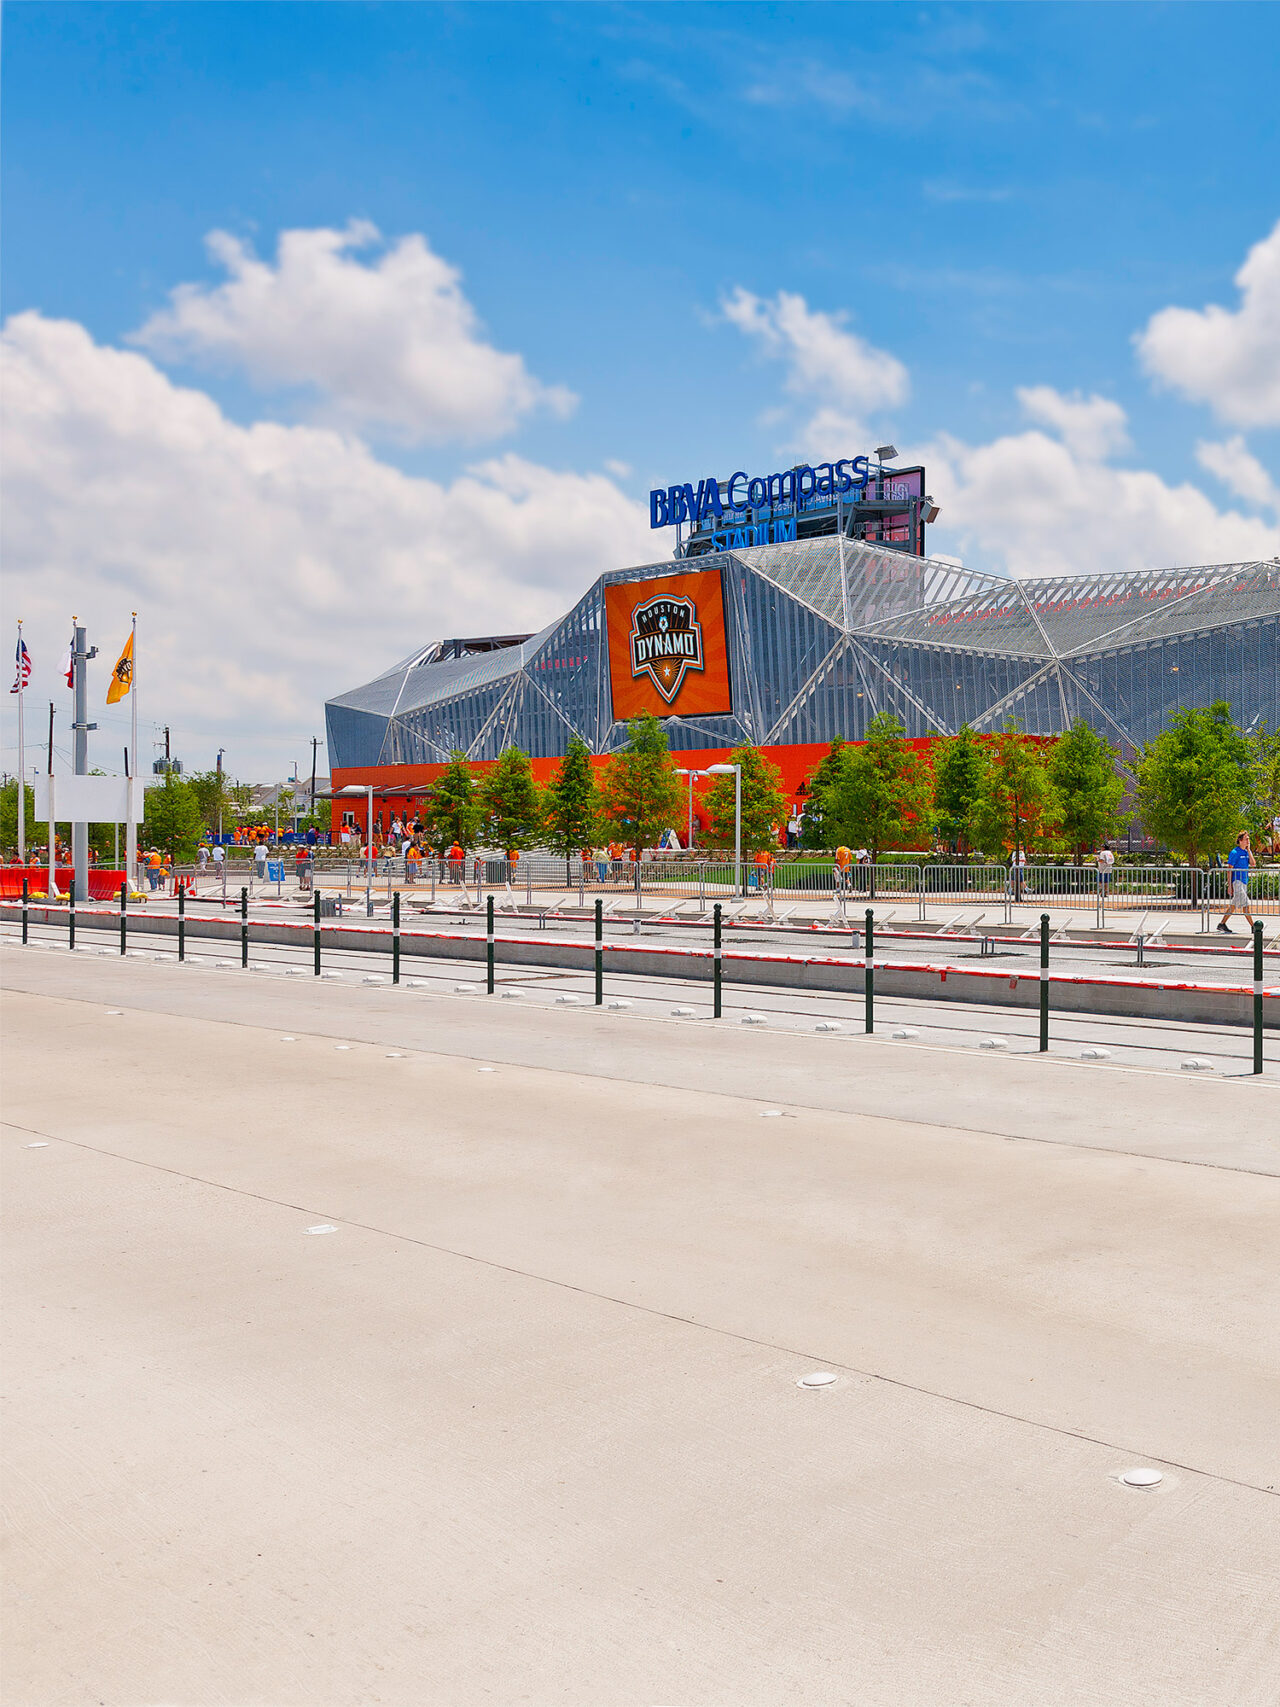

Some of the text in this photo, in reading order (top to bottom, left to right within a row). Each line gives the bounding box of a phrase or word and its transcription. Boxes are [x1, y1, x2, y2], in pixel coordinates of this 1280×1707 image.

[650, 455, 869, 529] BBVA Compass
[711, 518, 798, 552] STADIUM
[641, 604, 686, 624] HOUSTON
[635, 632, 695, 662] DYNAMO
